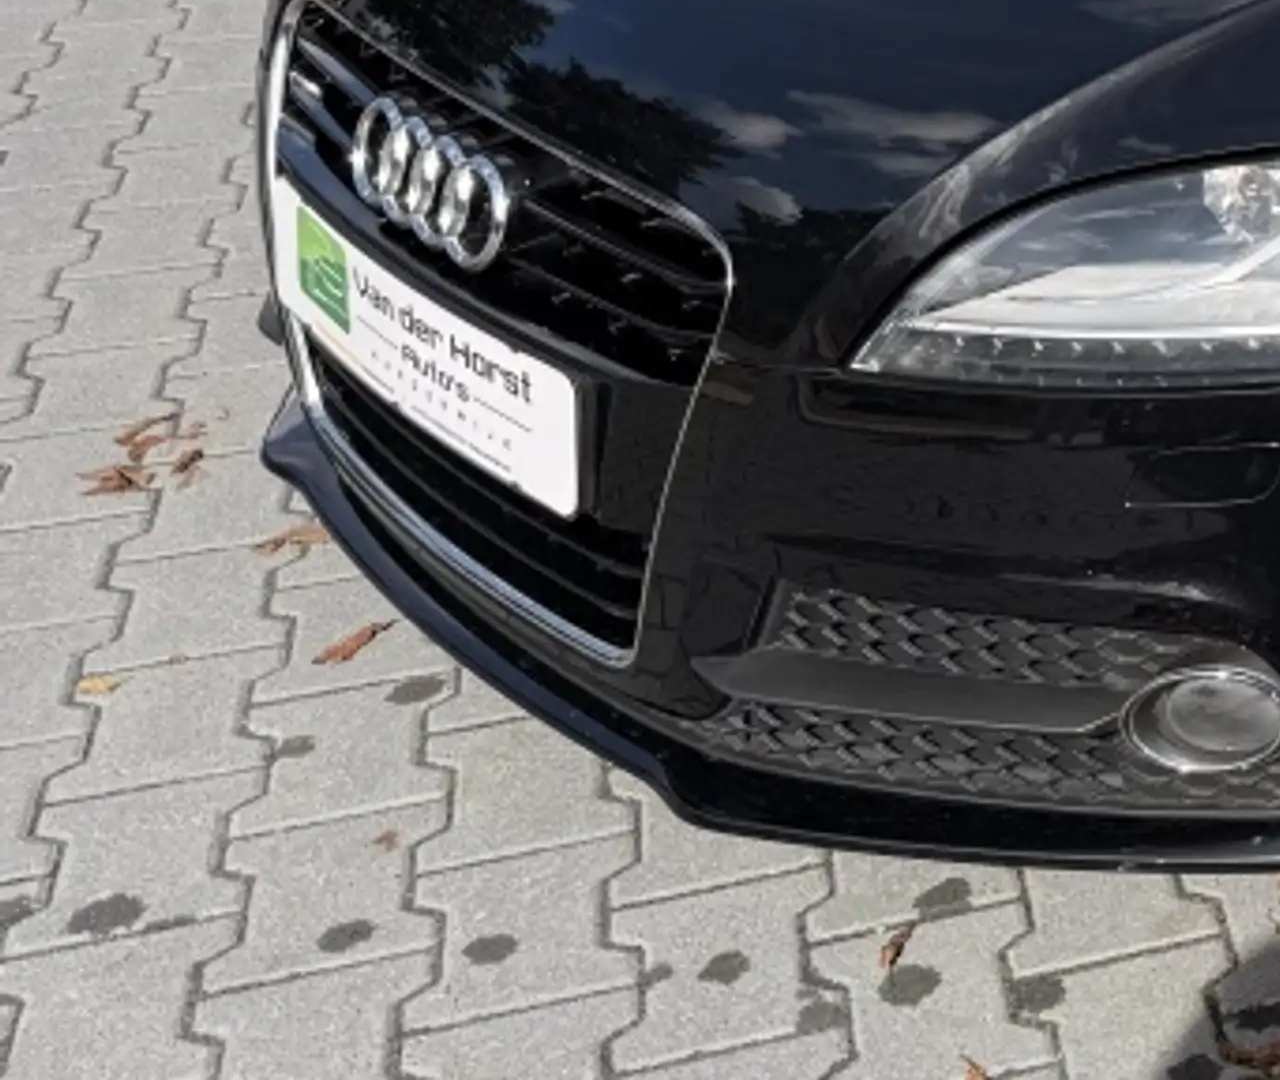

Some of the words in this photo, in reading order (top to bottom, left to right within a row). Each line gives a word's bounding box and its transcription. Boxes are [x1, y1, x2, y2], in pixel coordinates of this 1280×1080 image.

[352, 266, 395, 322] Van
[399, 304, 443, 349] der
[449, 333, 533, 405] Horst
